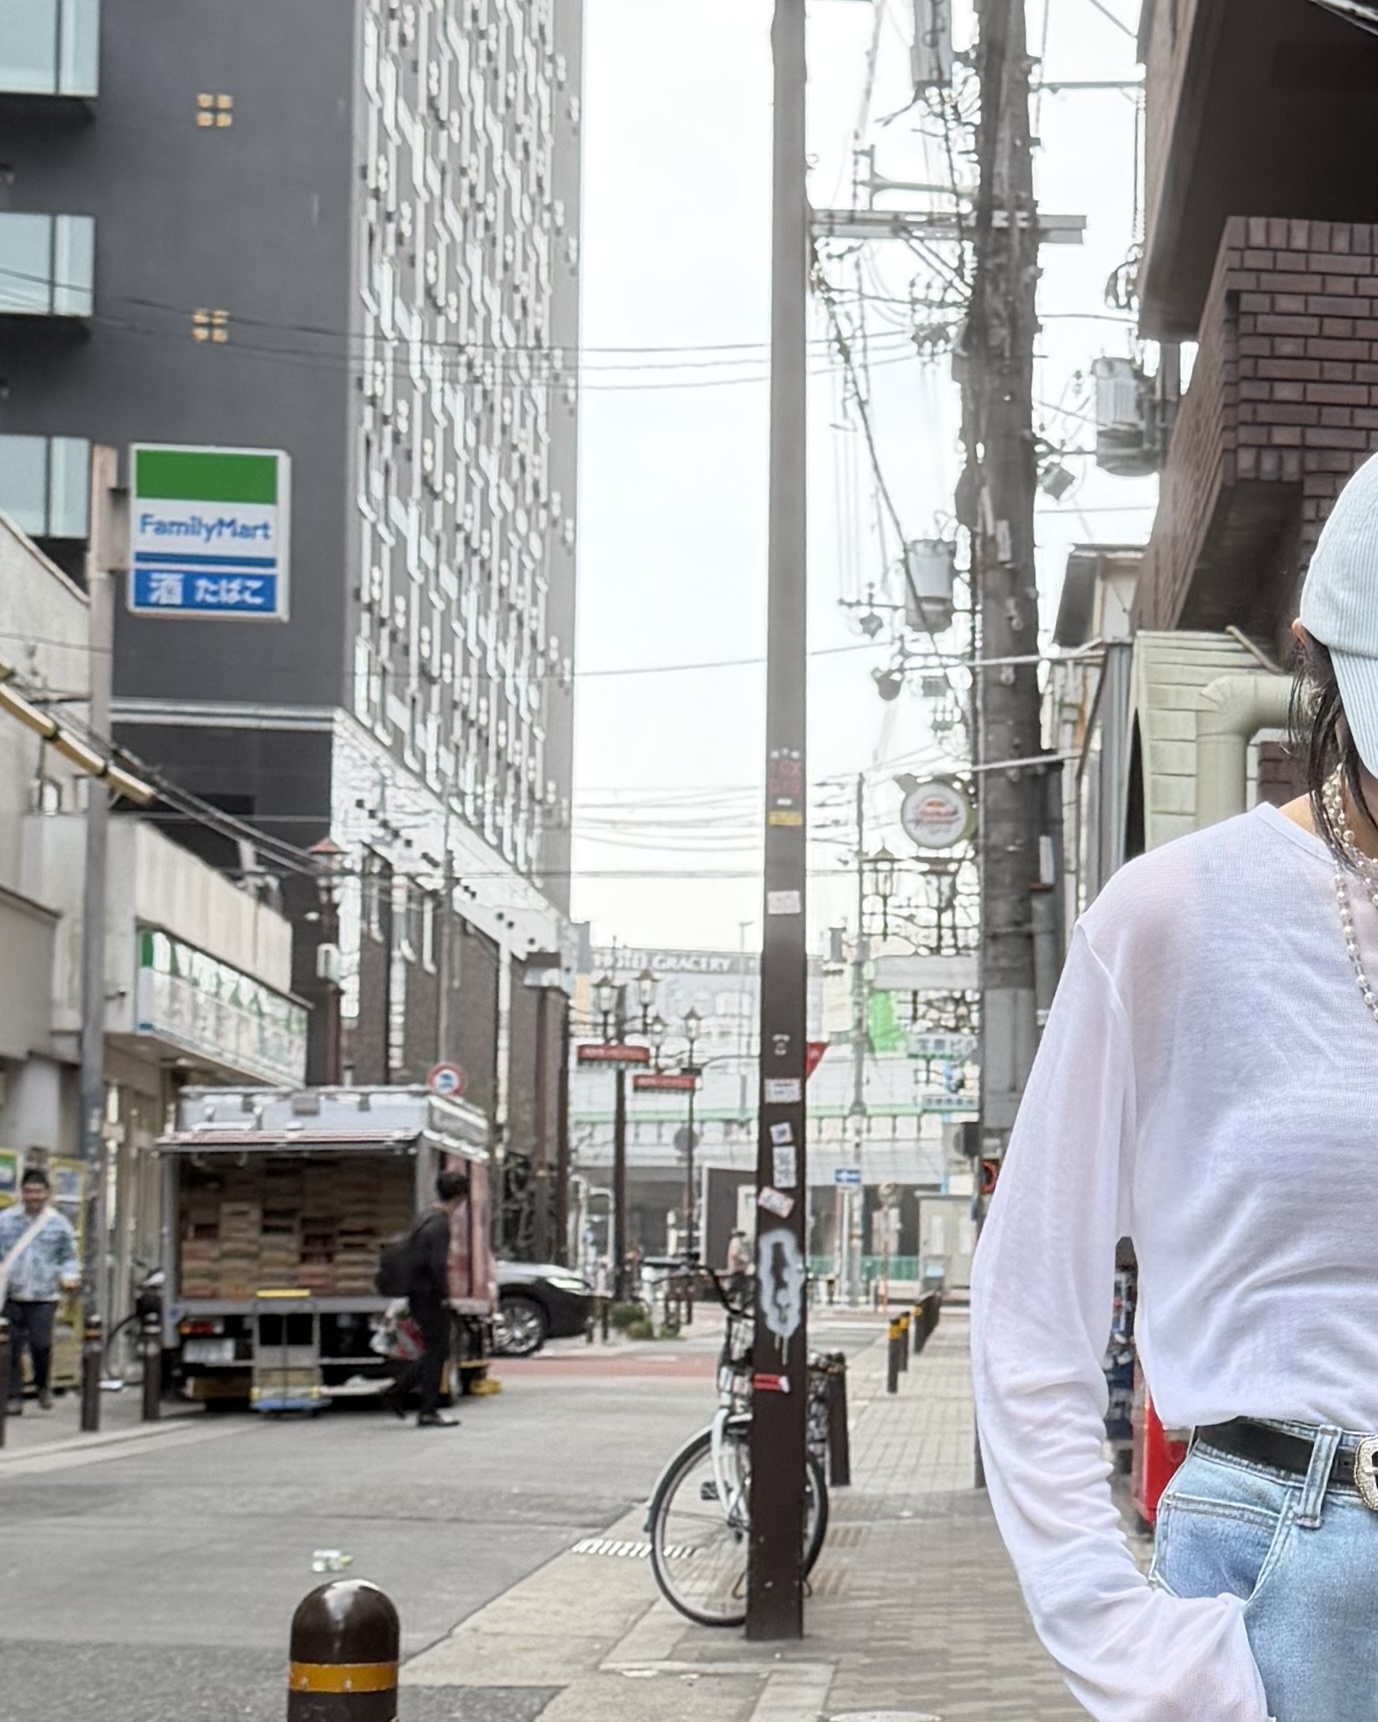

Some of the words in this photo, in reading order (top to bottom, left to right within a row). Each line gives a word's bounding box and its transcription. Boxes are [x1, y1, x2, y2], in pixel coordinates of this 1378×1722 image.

[140, 513, 271, 542] FamilyMart
[148, 572, 184, 606] 酒
[195, 577, 265, 605] たばこ
[652, 954, 733, 972] GRACERY
